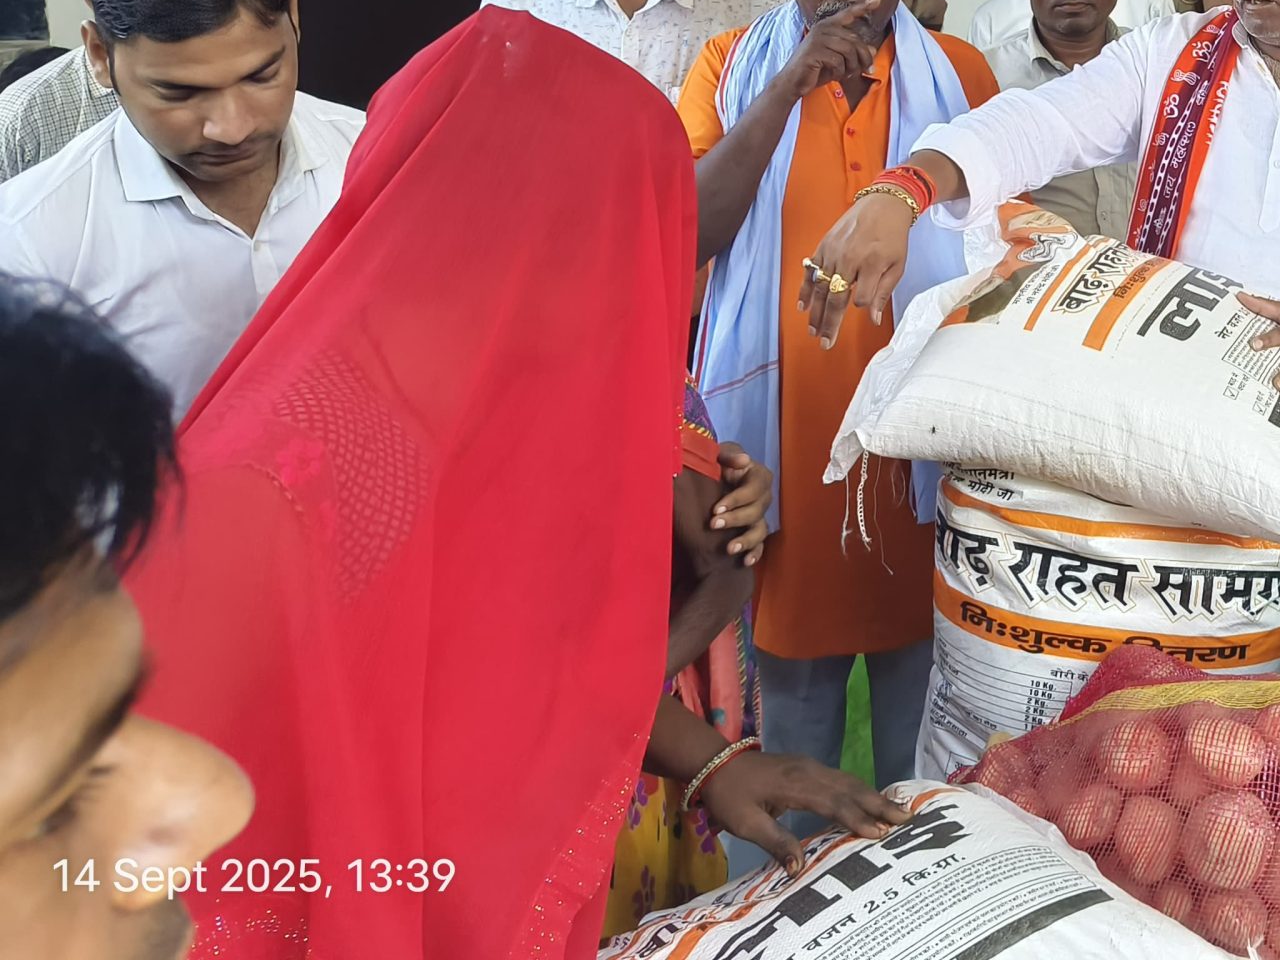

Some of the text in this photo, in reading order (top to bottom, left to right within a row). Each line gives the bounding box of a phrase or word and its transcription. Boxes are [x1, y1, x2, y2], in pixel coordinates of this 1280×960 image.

[1163, 121, 1197, 200] जय महाकाल
[1059, 243, 1130, 309] बाढ़ राहत
[1214, 312, 1245, 339] नेट वजन
[967, 479, 995, 494] मोदी
[1009, 541, 1140, 607] राहत
[1050, 668, 1075, 680] बोरी
[1042, 681, 1057, 691] Kg.
[1041, 690, 1056, 700] Kg.
[1035, 699, 1049, 708] Kg.
[1033, 708, 1047, 717] Kg.
[1033, 716, 1046, 725] Kg.
[802, 854, 966, 952] वजन 2.5 कि.ग्रा.
